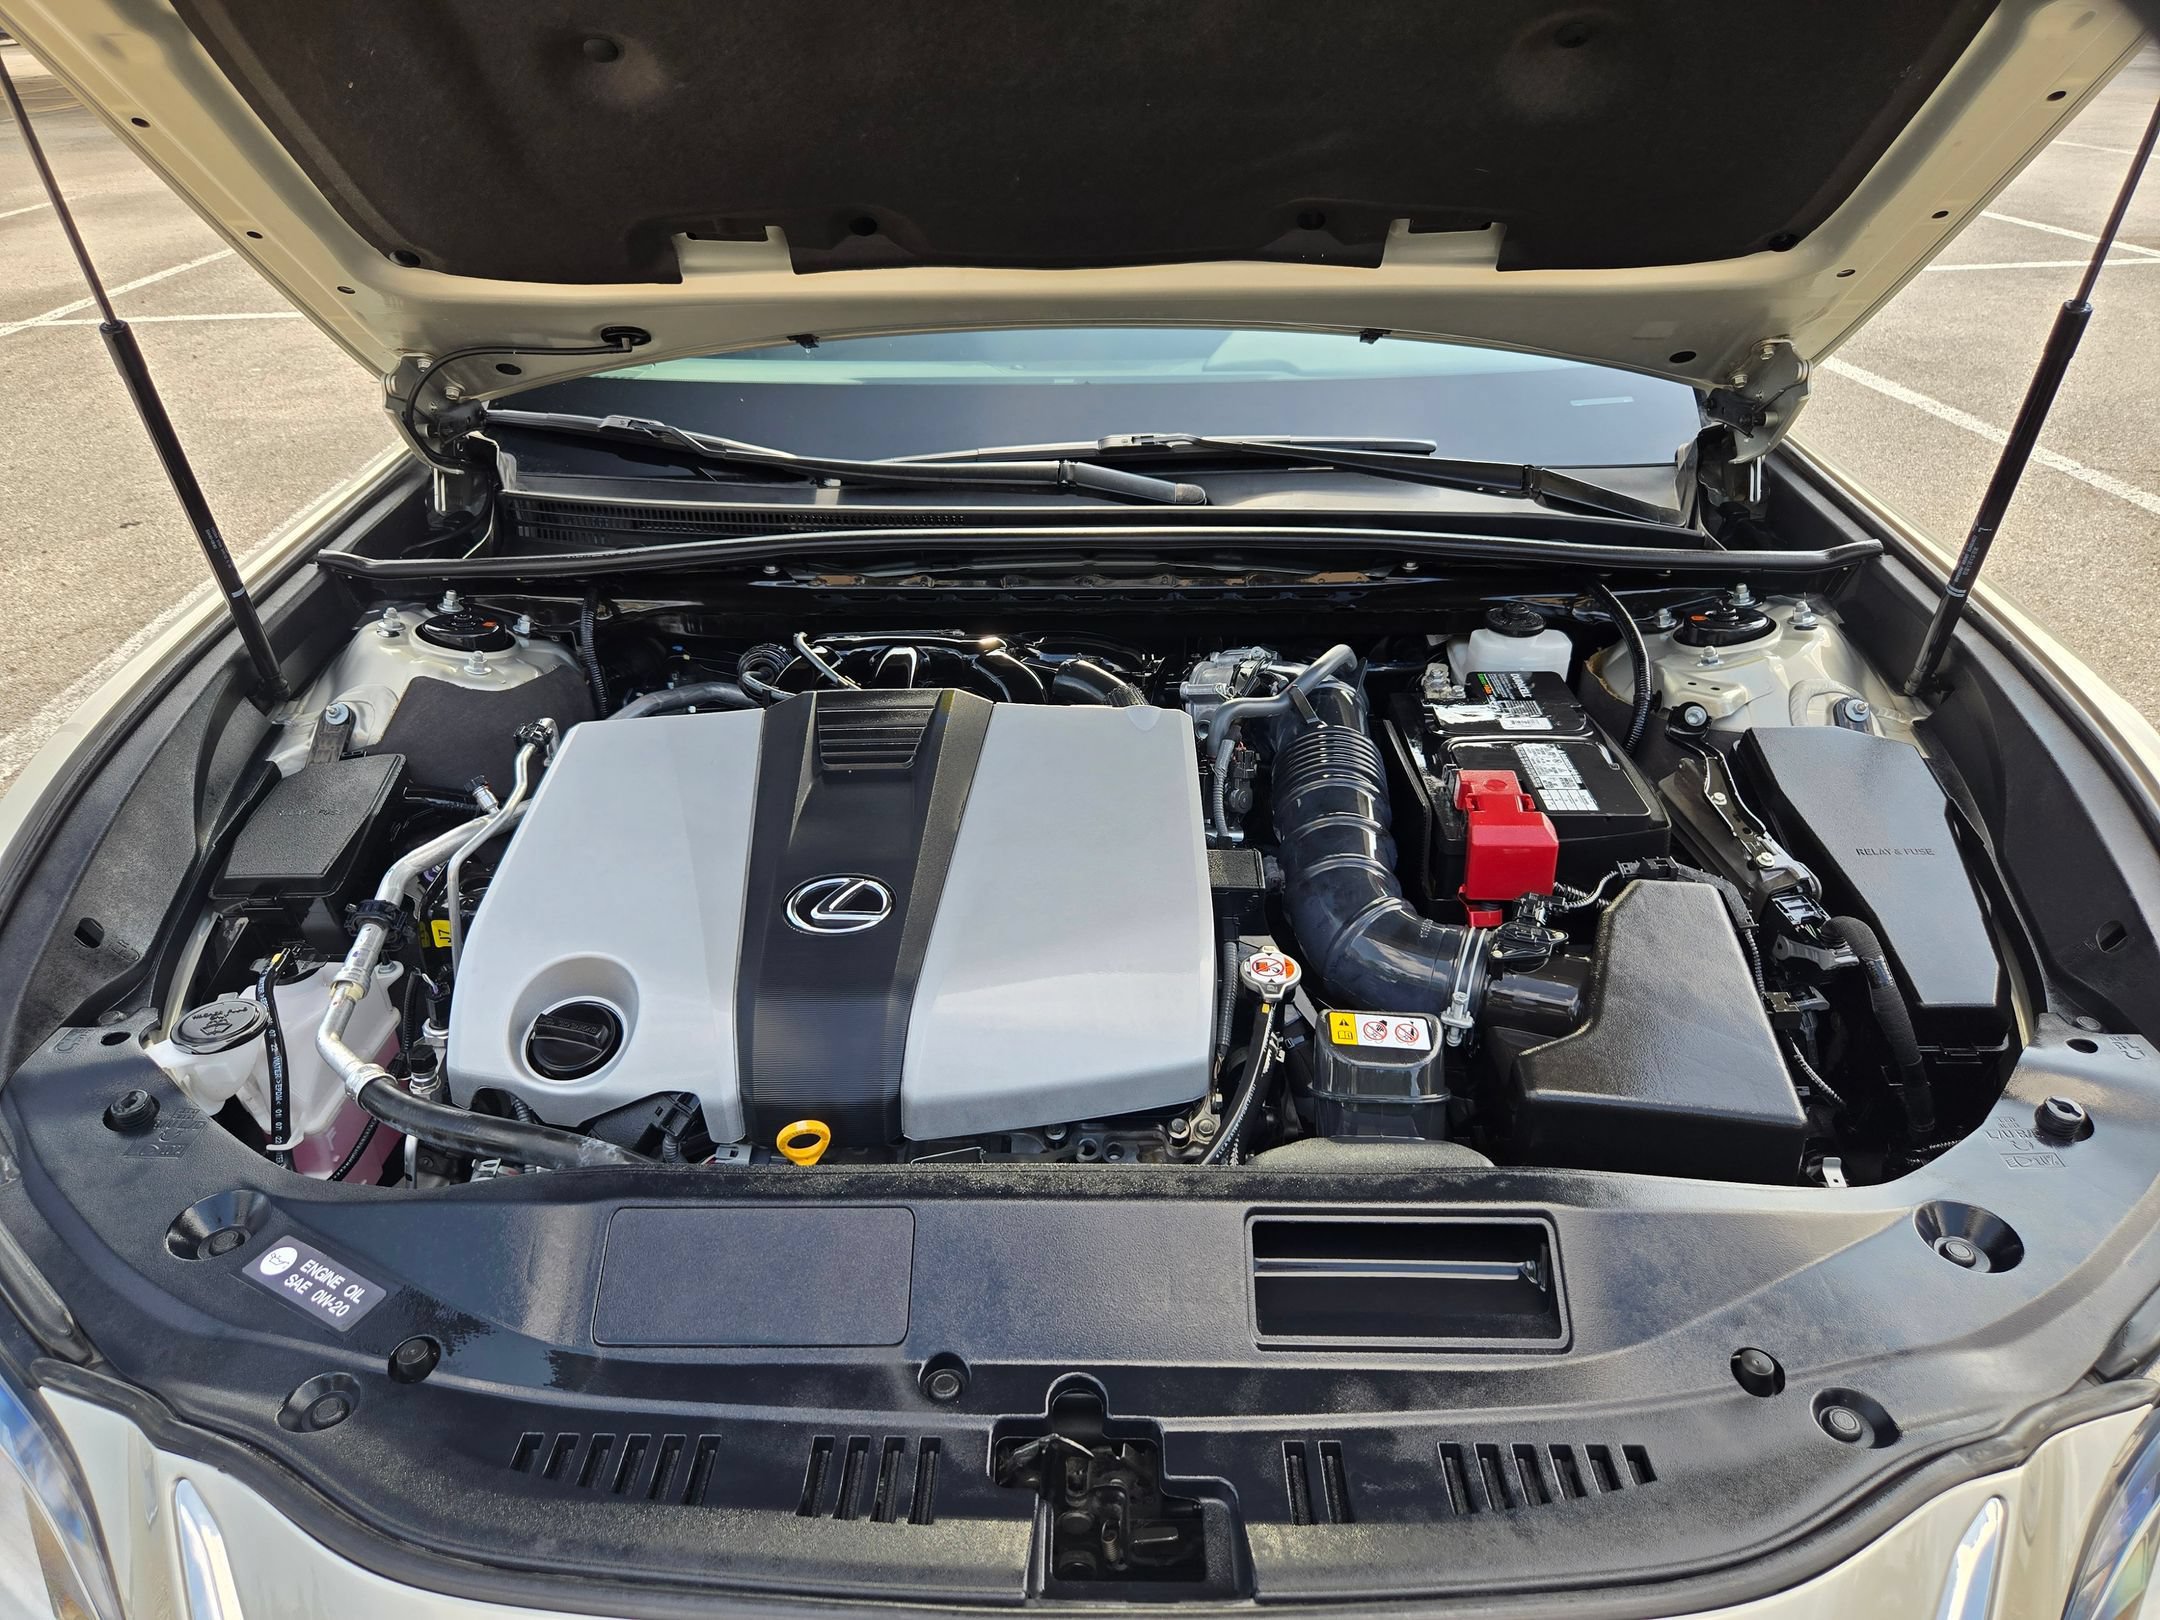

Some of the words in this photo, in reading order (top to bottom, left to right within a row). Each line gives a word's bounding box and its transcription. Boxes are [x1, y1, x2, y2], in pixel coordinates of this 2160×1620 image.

[1855, 848, 1892, 856] RELAY
[1903, 848, 1935, 856] FUSE
[272, 1056, 282, 1079] WATER
[284, 1273, 313, 1294] SAE
[310, 1289, 350, 1317] 0W-20
[300, 1259, 345, 1290] ENGINE
[344, 1284, 366, 1304] OIL
